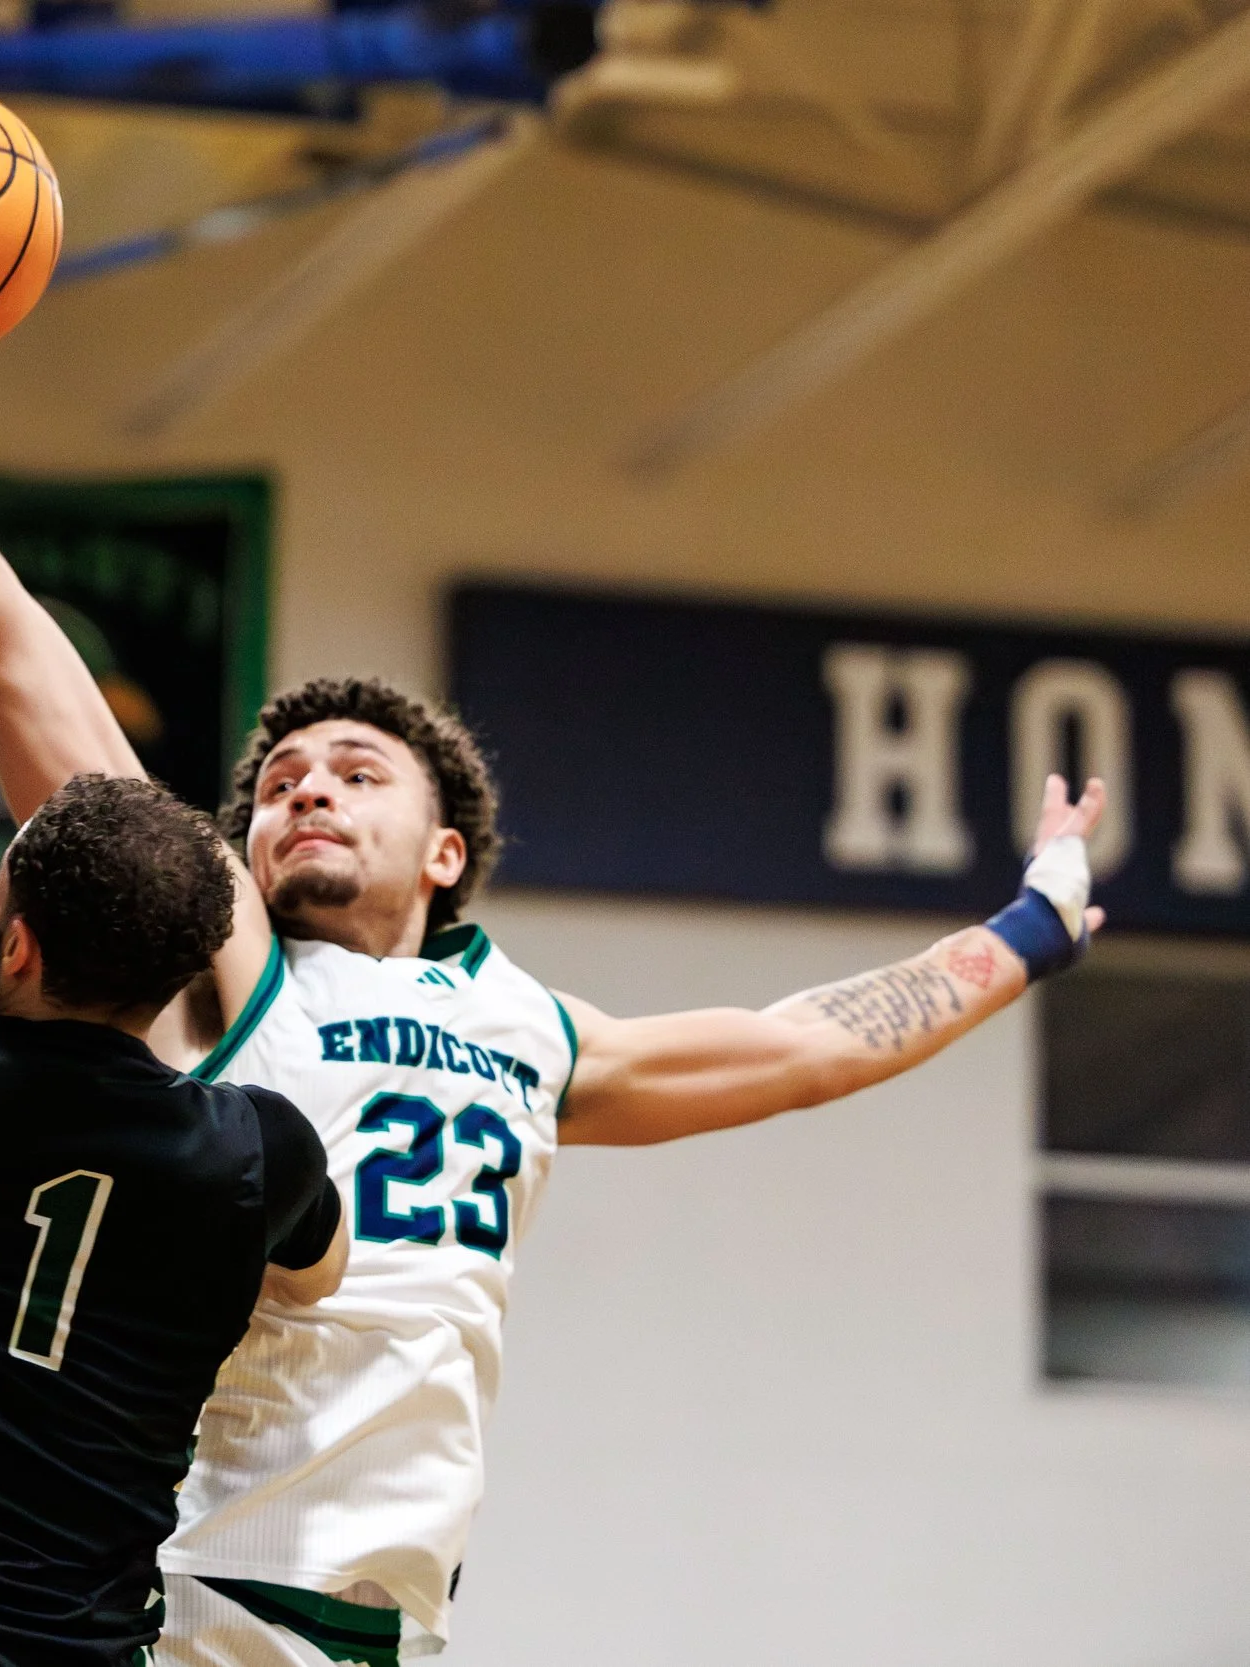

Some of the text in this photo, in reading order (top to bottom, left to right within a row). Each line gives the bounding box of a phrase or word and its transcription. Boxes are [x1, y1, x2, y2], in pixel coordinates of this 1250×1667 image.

[317, 1016, 540, 1113] ENDICOTT
[354, 1091, 522, 1262] 23
[8, 1169, 114, 1372] 1
